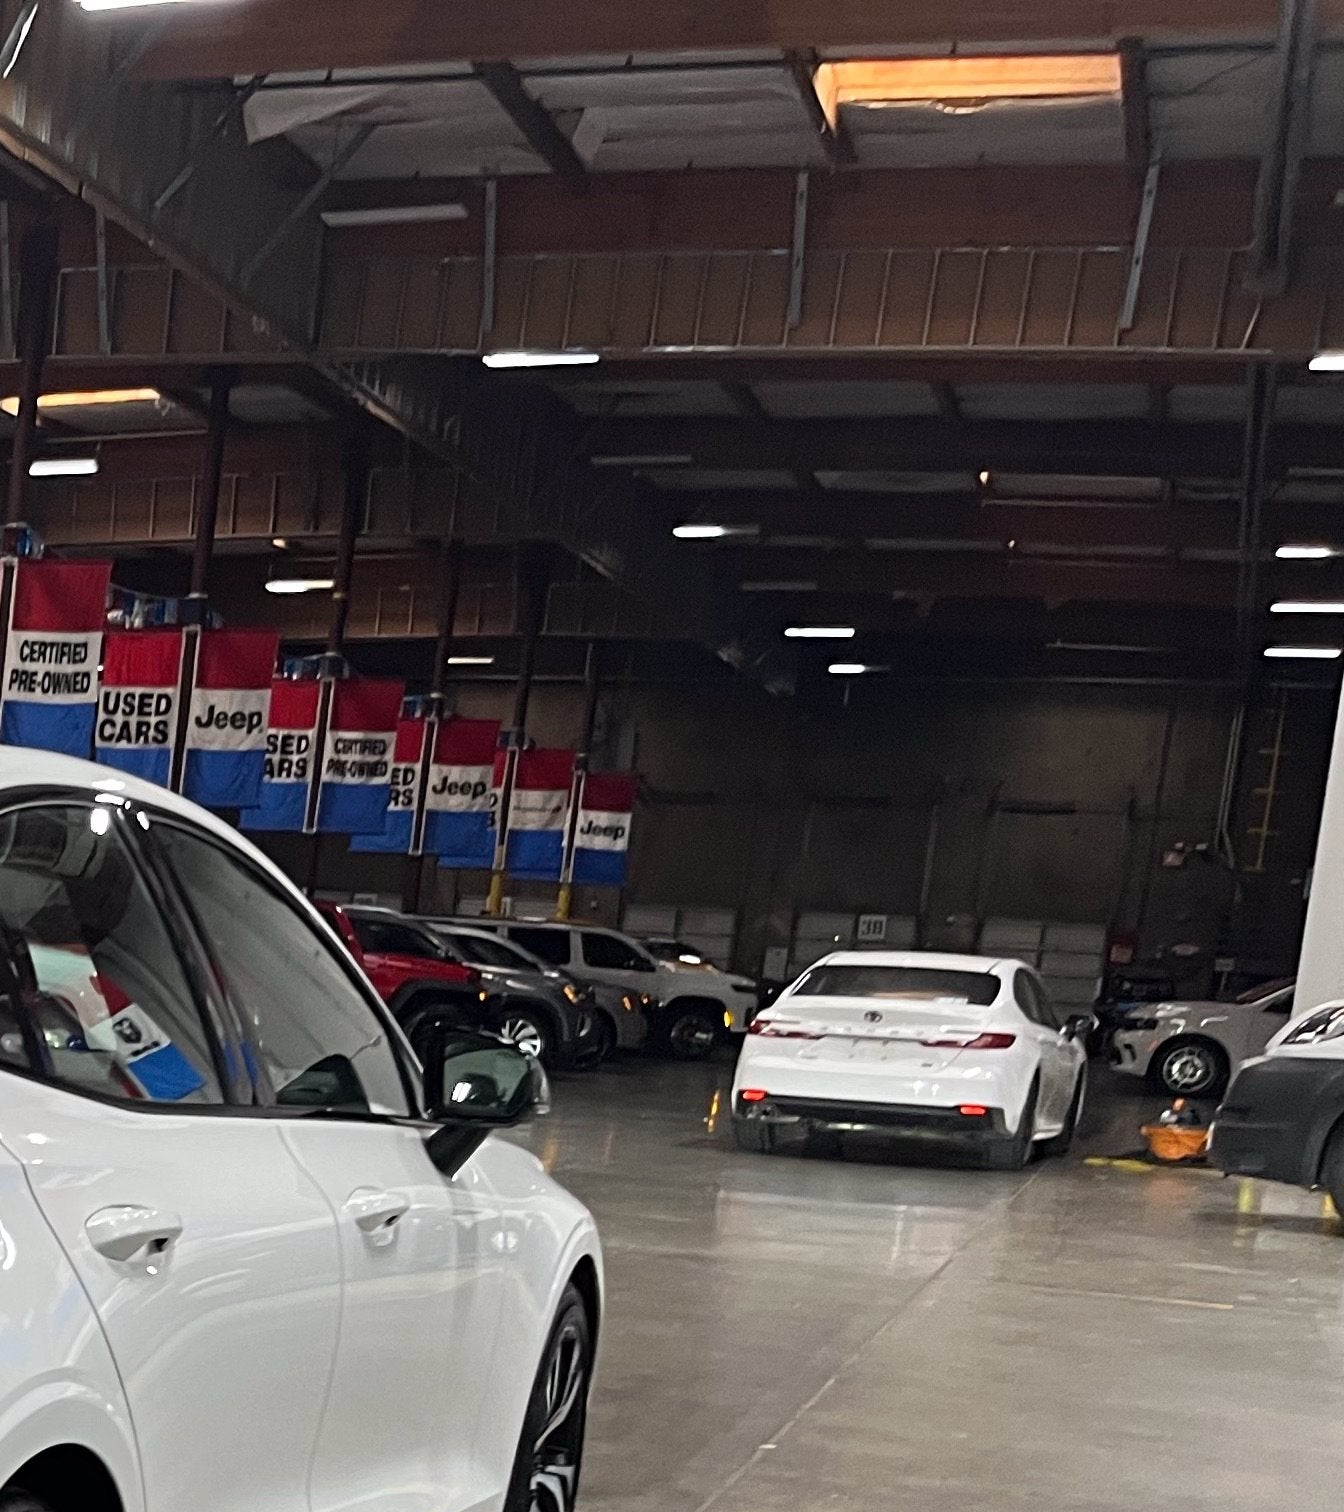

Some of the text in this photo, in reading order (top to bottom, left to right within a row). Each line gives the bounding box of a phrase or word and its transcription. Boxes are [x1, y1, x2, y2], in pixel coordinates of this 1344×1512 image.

[19, 639, 88, 664] CERTIFIED
[8, 669, 91, 694] PRE-OWNED
[102, 691, 172, 717] USED
[194, 705, 262, 735] Jeep
[98, 719, 169, 745] CARS
[265, 734, 310, 755] SED
[334, 738, 387, 756] CERTIFIED
[264, 757, 307, 779] ARS
[326, 758, 388, 778] PRE-OWNED
[390, 767, 416, 786] ED
[432, 775, 487, 800] Jeep
[579, 820, 626, 841] Jeep
